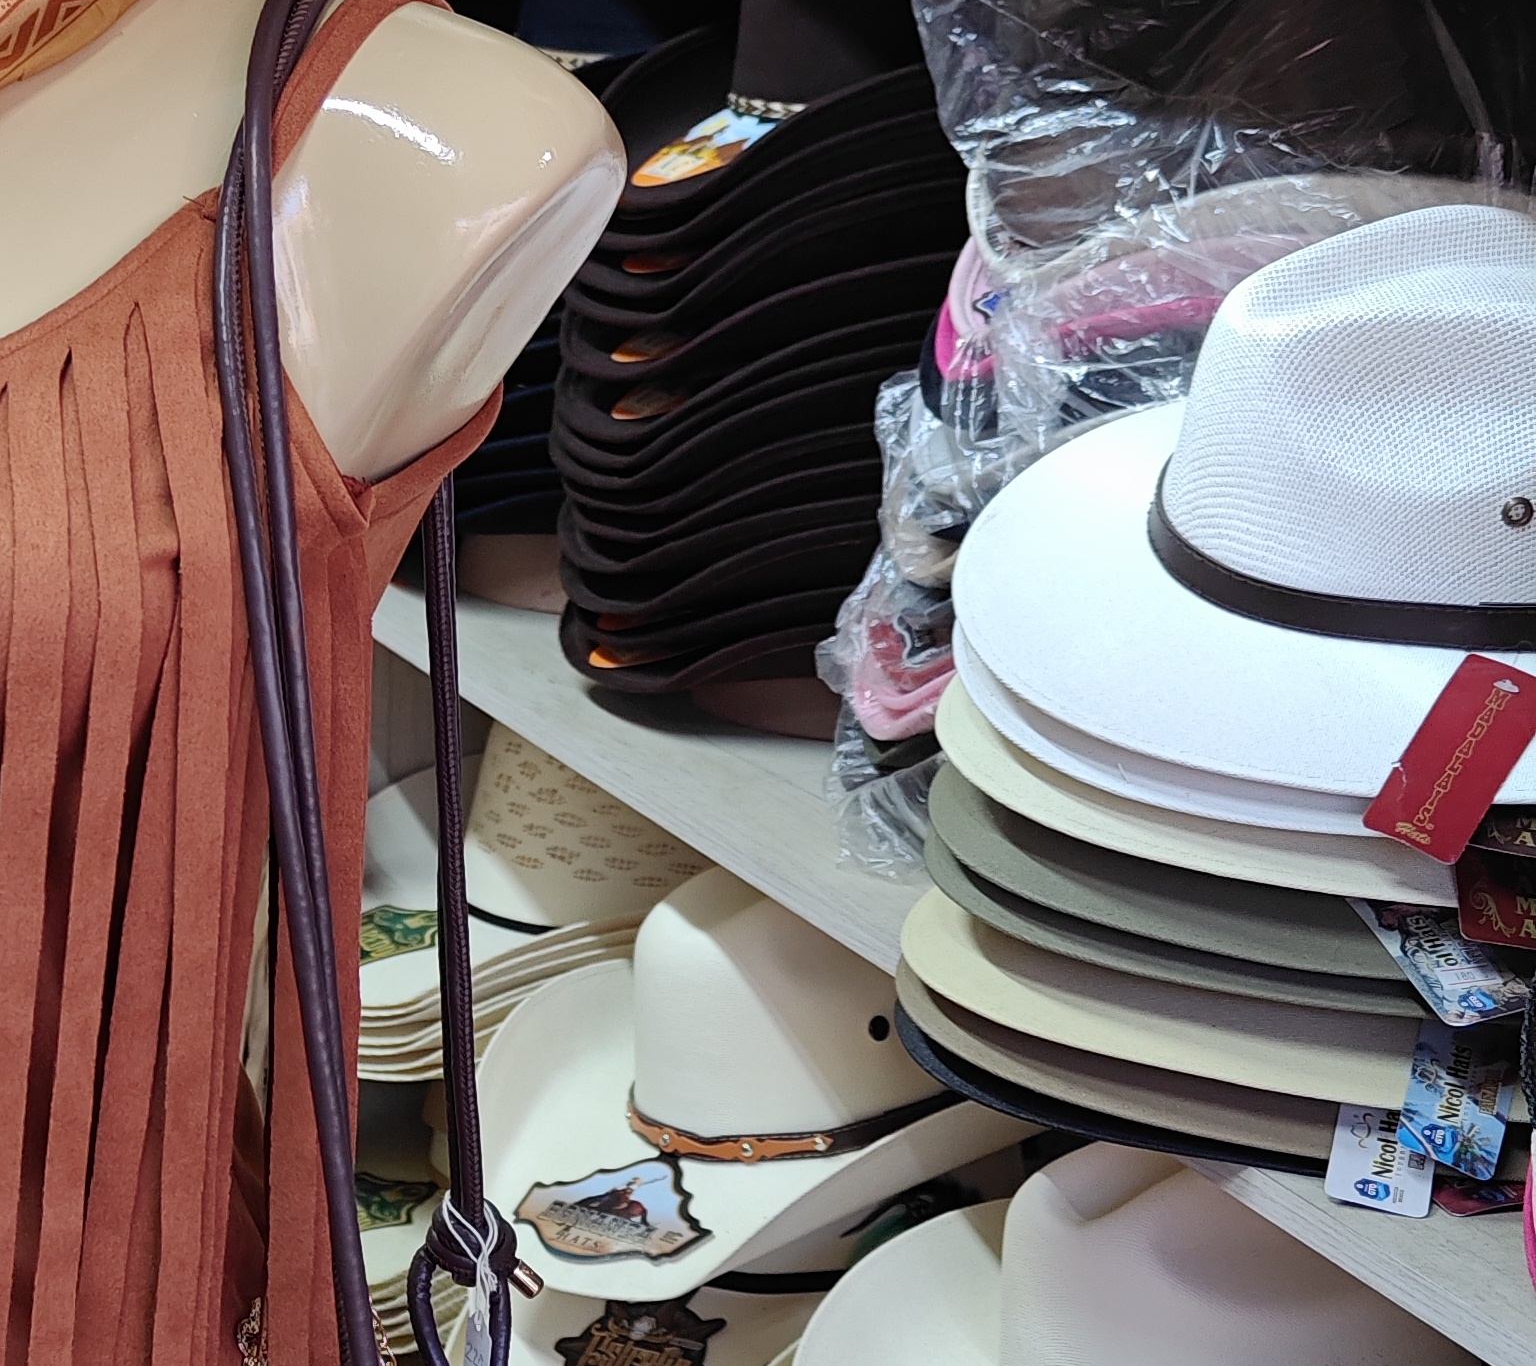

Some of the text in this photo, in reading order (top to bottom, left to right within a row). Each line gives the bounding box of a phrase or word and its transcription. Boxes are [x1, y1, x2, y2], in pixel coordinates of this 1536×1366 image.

[1437, 1044, 1473, 1126] Nicol Hats
[1378, 1108, 1401, 1131] Ha
[1371, 1134, 1399, 1180] Nicol
